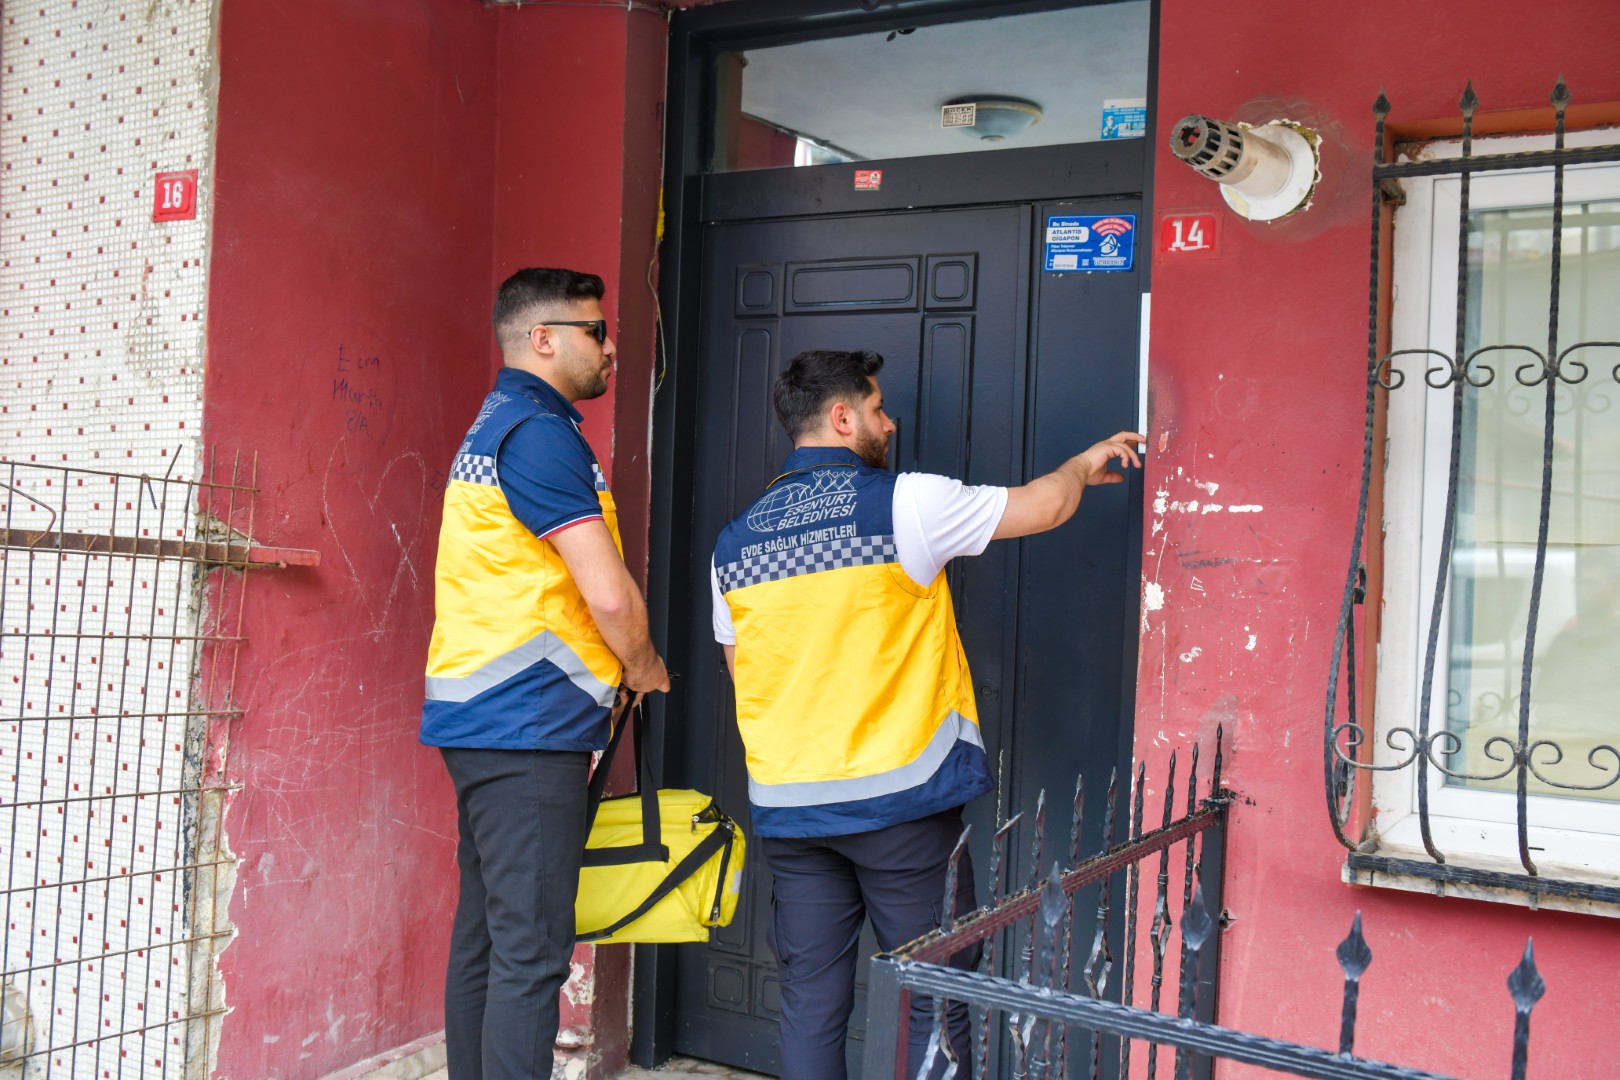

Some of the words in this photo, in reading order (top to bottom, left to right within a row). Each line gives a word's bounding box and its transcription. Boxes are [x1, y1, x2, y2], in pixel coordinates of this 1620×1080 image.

[162, 180, 184, 209] 16
[1171, 219, 1205, 251] 14
[776, 502, 857, 531] BELEDİYESİ
[784, 493, 858, 518] ESENYURT
[741, 542, 763, 560] EVDE
[764, 534, 799, 554] SAĞLIK
[800, 521, 857, 546] HİZMETLERİ
